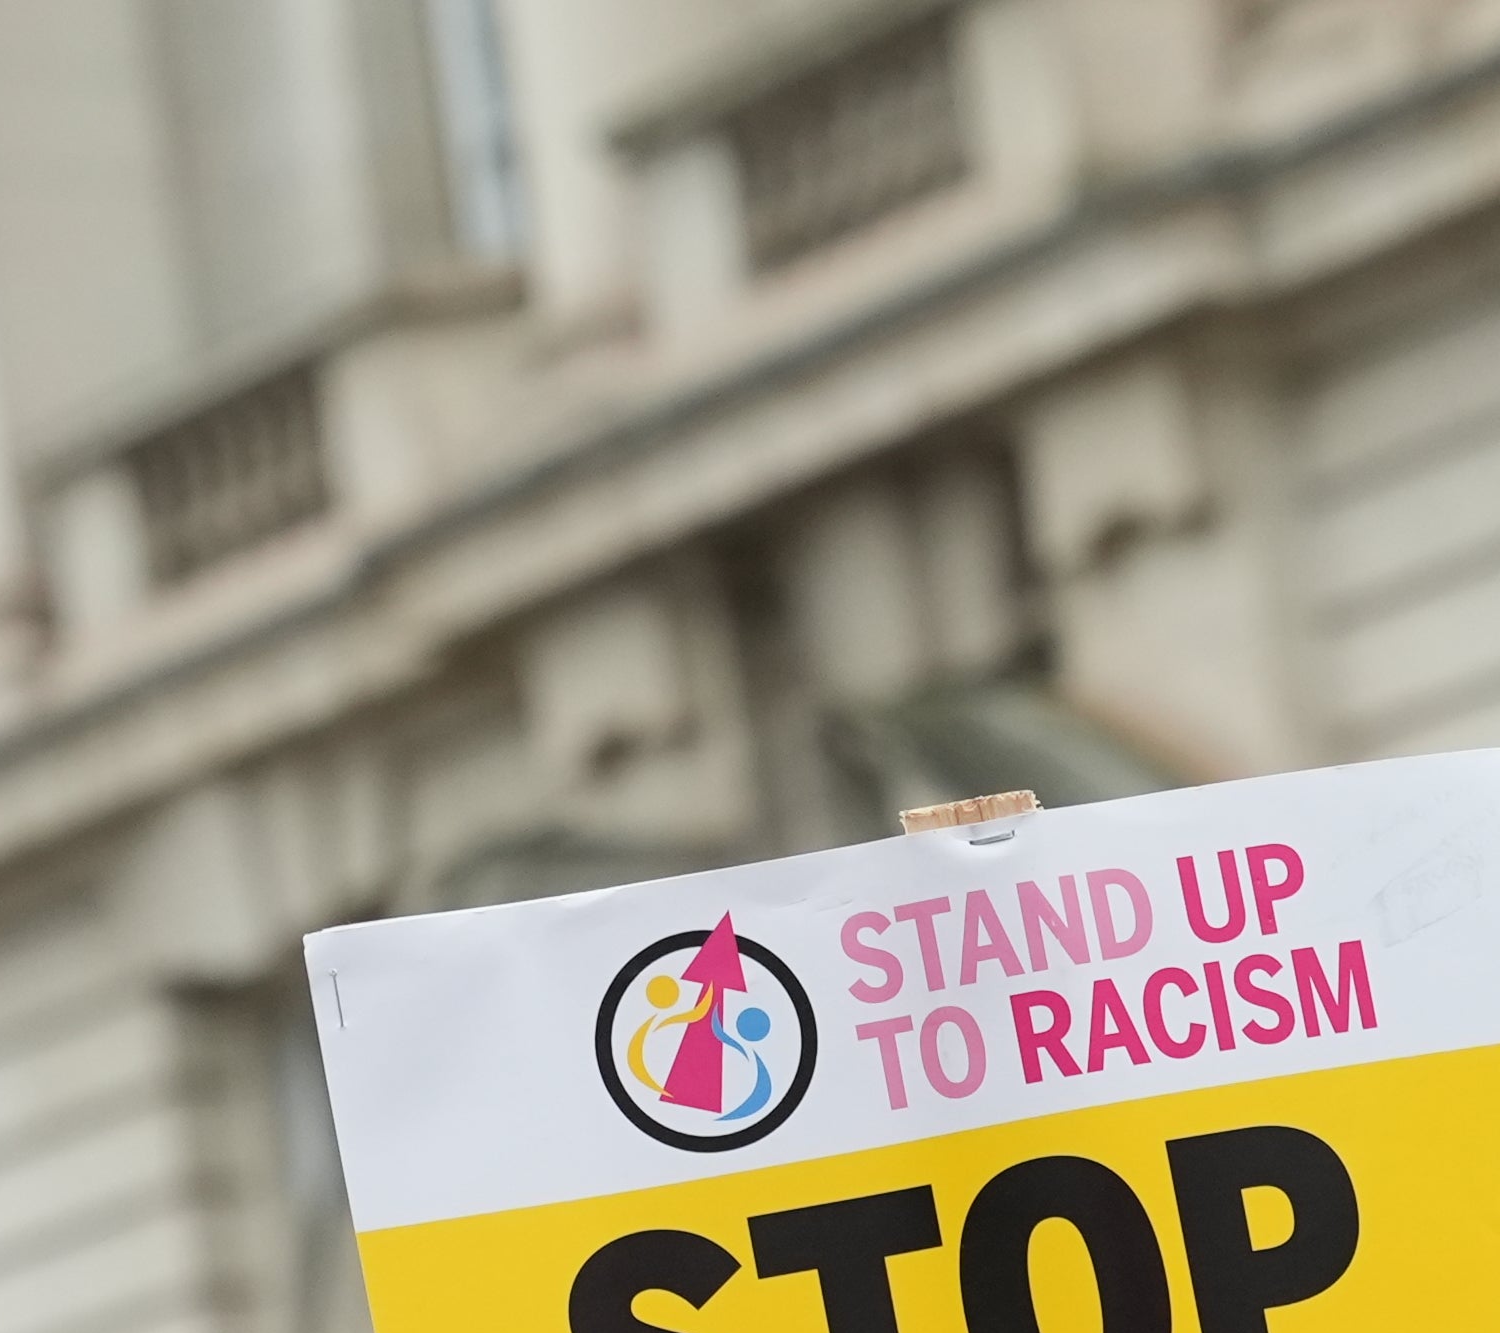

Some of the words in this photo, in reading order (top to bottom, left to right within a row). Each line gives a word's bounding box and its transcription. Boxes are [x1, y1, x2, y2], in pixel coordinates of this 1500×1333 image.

[842, 870, 1153, 1003] STAND
[1176, 842, 1306, 945] UP
[857, 1006, 987, 1109] TO
[1009, 939, 1379, 1085] RACISM
